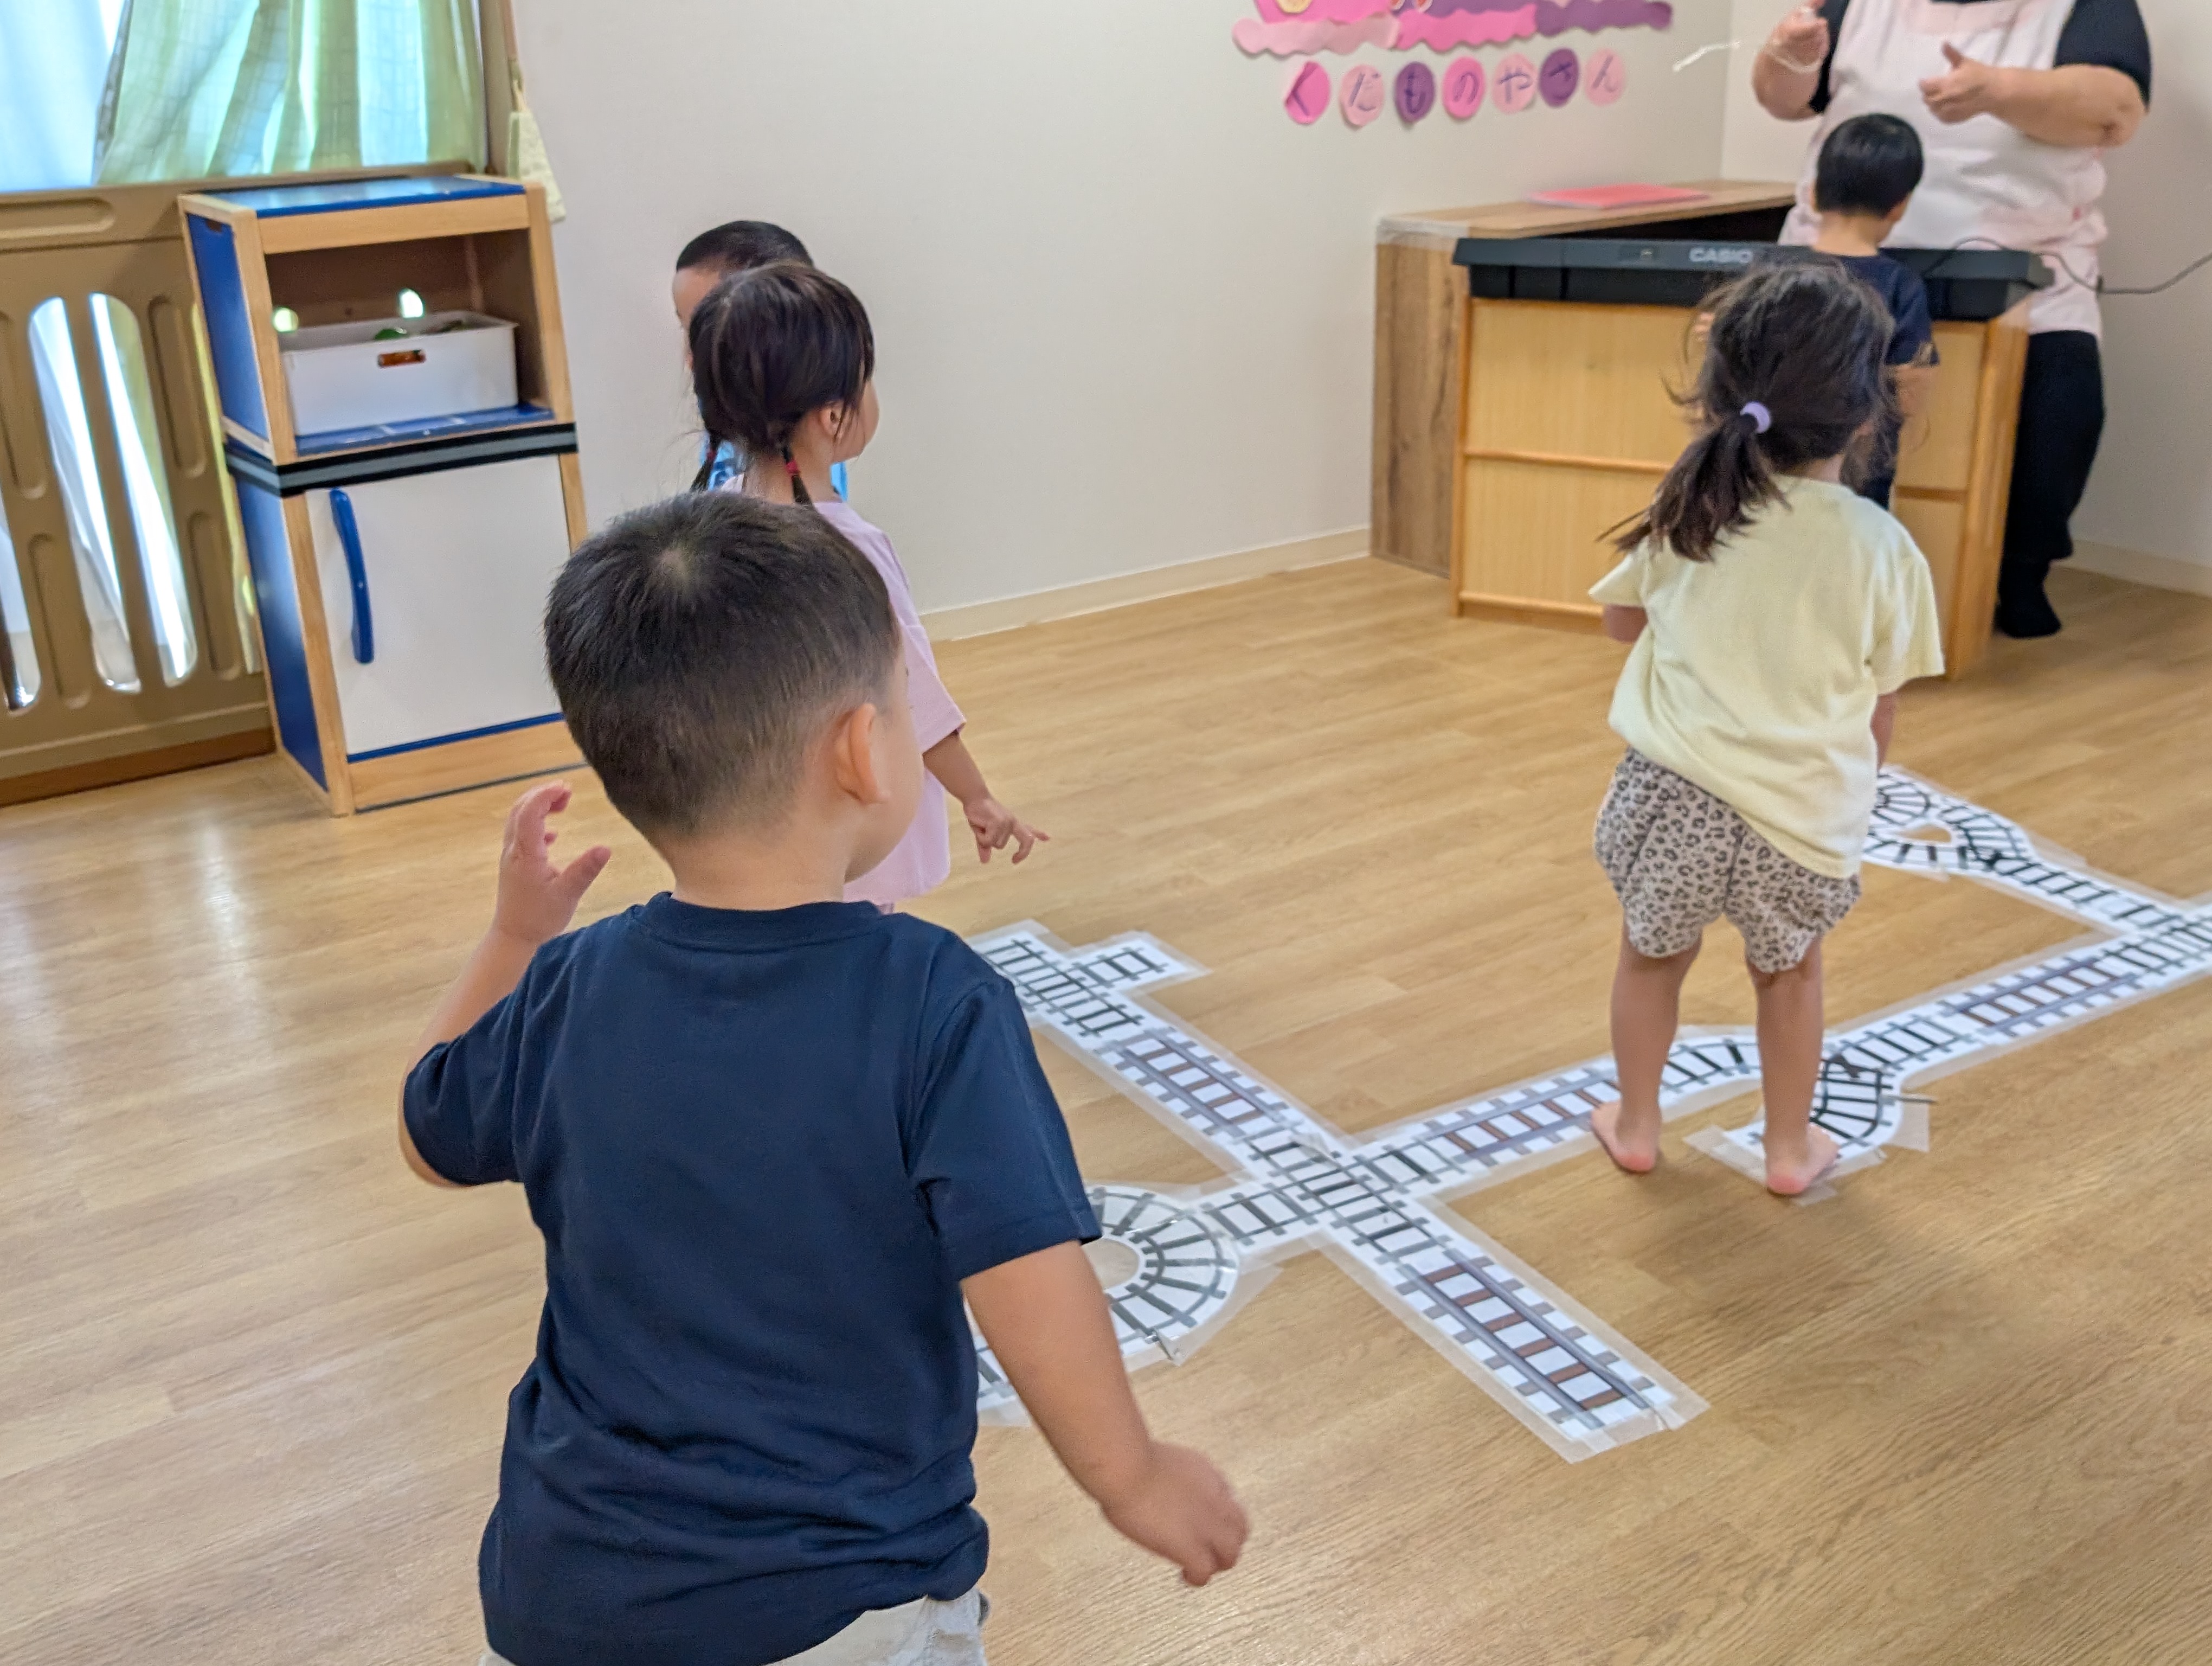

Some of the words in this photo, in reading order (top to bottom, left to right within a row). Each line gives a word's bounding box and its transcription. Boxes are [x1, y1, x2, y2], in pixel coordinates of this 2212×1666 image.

[1290, 55, 1618, 116] くだものやさん
[1689, 247, 1753, 264] CASIO
